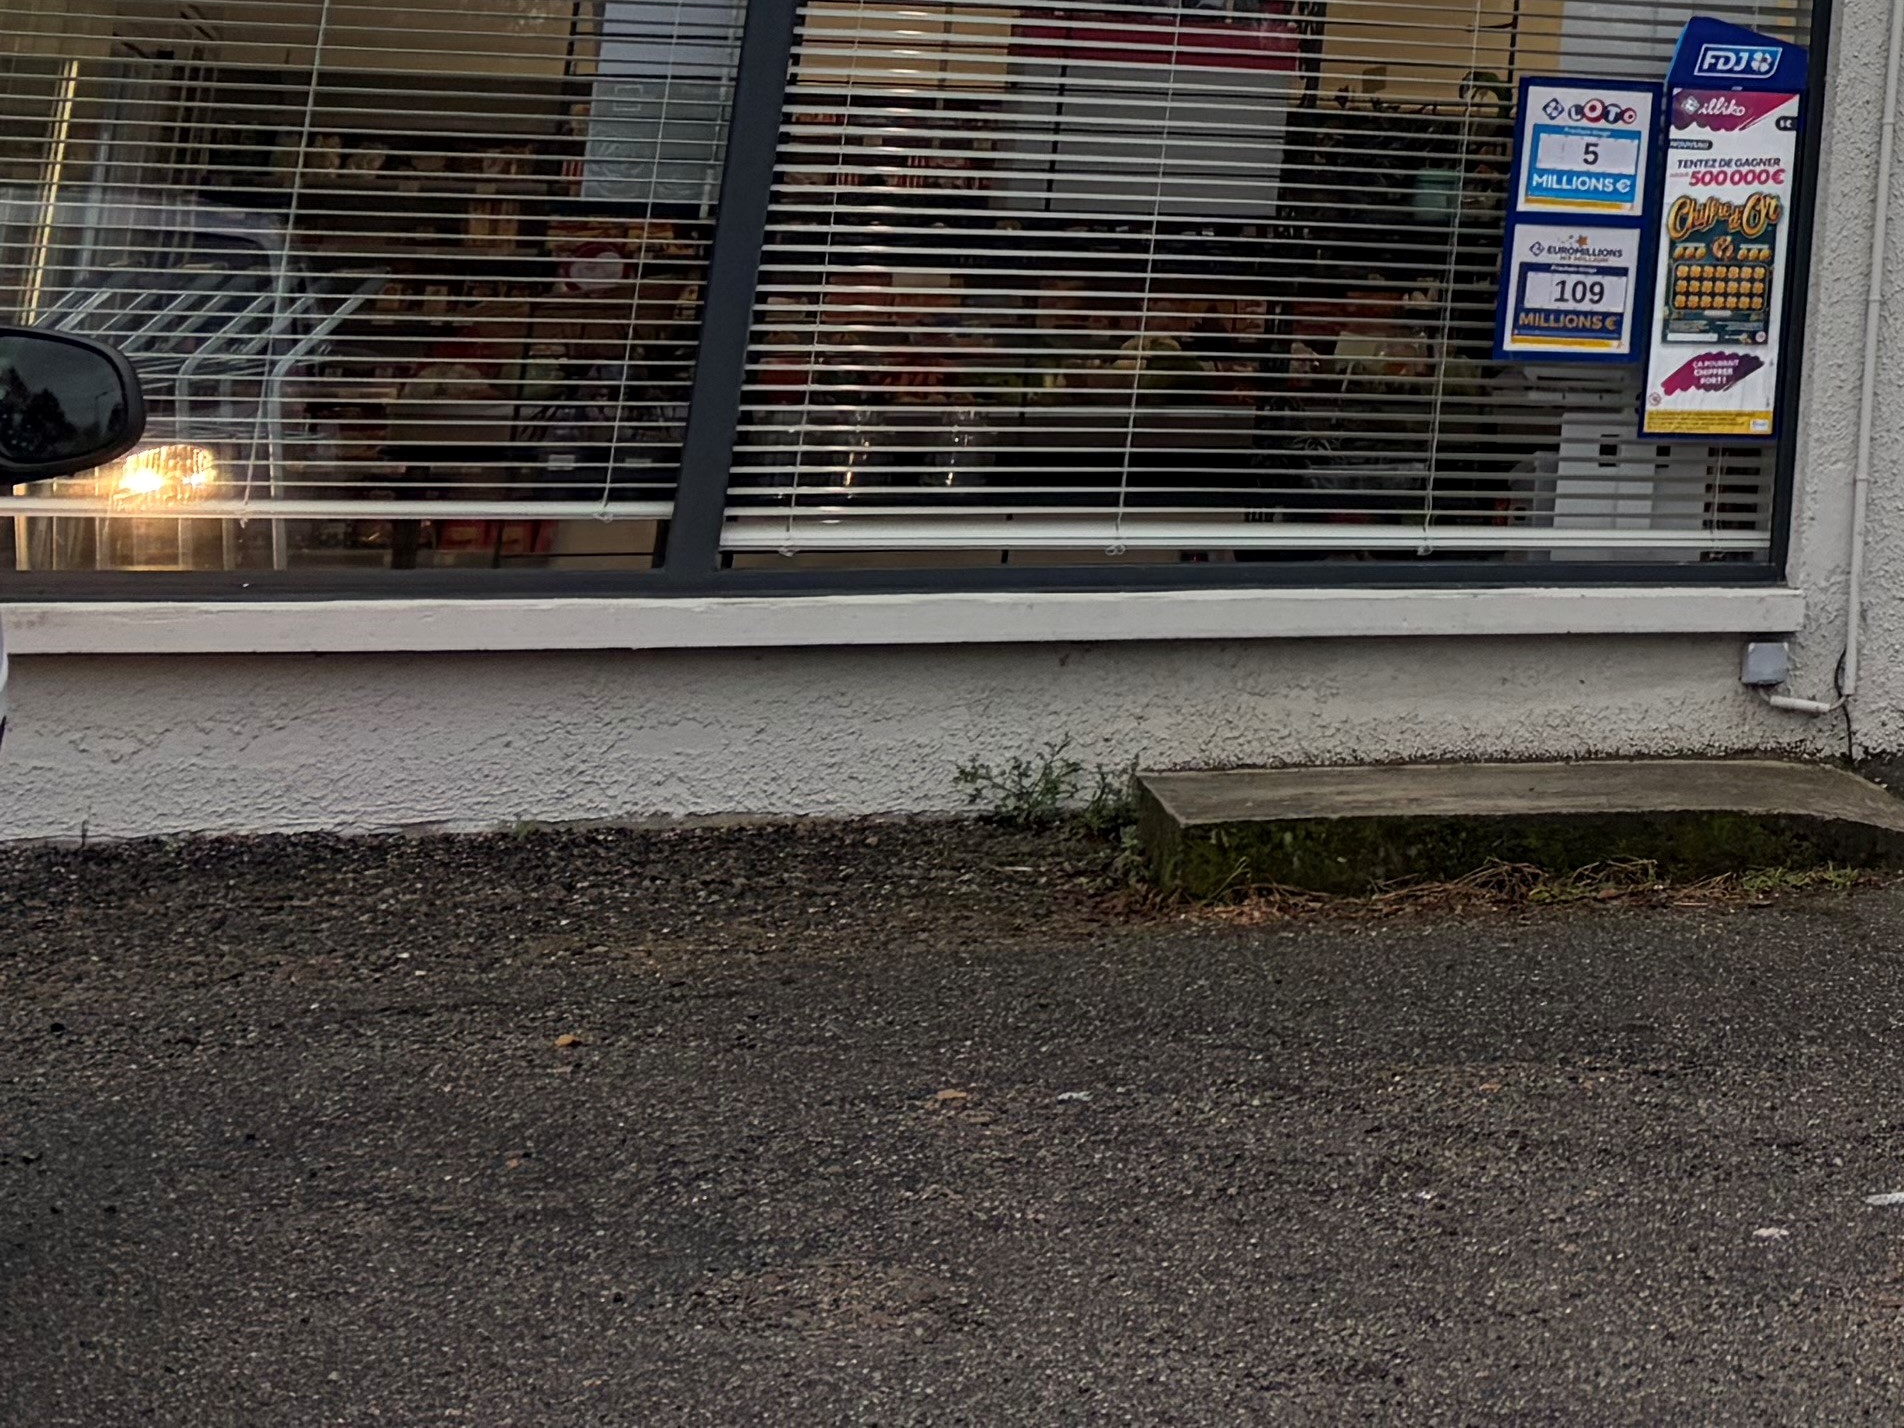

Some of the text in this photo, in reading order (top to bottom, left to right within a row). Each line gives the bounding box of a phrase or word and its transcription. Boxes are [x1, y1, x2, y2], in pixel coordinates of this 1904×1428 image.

[1702, 50, 1749, 72] FDJ
[1568, 98, 1638, 125] LOTO
[1698, 96, 1746, 116] illiko
[1583, 142, 1600, 165] 5
[1677, 157, 1781, 169] TENTEZ DE GAGNER
[1532, 173, 1614, 192] MILLIONS
[1688, 170, 1728, 187] 500
[1547, 245, 1624, 259] EUROMILLIONS
[1553, 279, 1606, 305] 109
[1518, 312, 1603, 330] MILLIONS
